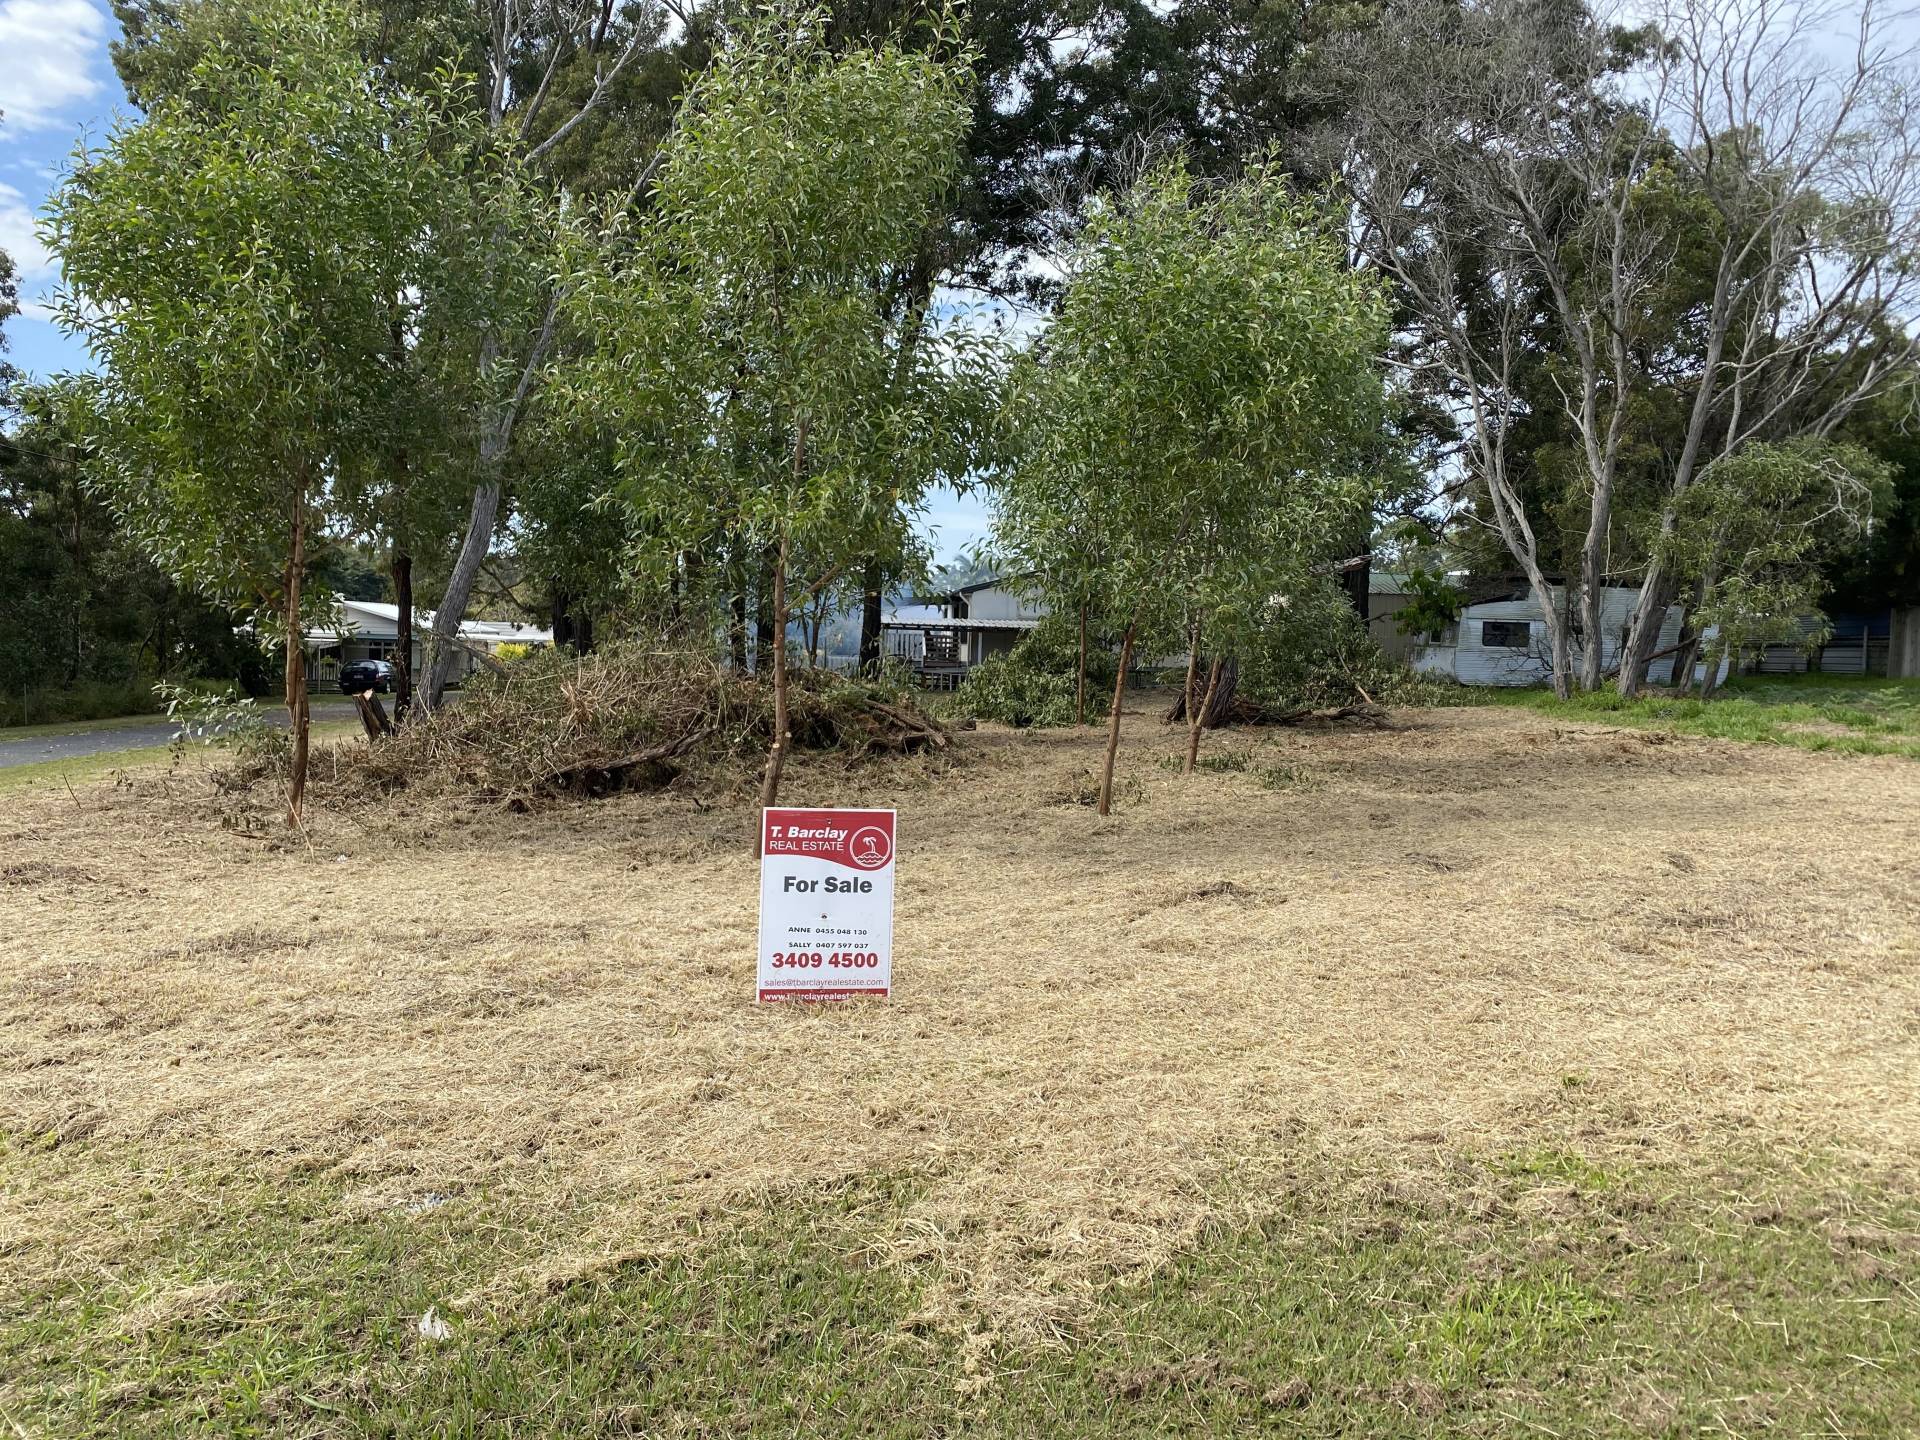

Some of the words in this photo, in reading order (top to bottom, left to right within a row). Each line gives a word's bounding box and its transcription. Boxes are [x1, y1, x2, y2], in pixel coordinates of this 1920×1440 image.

[770, 826, 783, 838] T.
[788, 826, 848, 842] Barclay
[769, 841, 799, 851] REAL
[802, 841, 844, 851] ESTATE
[784, 876, 818, 893] For
[824, 876, 873, 893] Sale
[772, 952, 822, 968] 3409
[828, 953, 878, 968] 4500
[764, 978, 884, 988] sales@tbarclayrealestate.com
